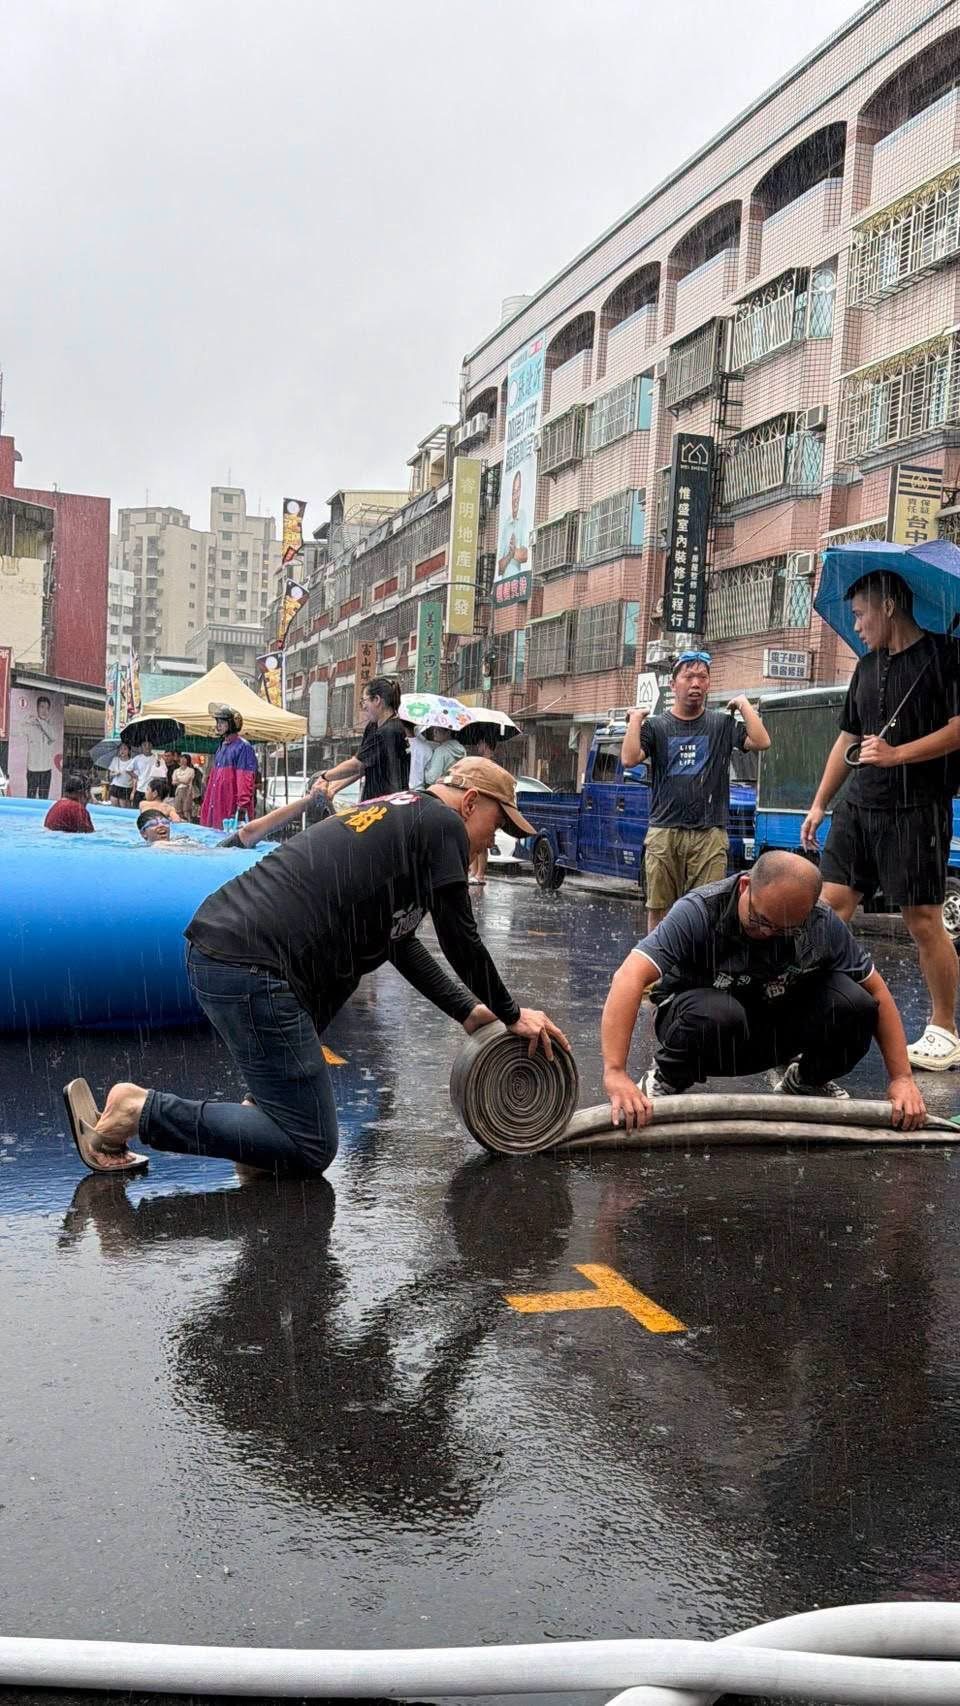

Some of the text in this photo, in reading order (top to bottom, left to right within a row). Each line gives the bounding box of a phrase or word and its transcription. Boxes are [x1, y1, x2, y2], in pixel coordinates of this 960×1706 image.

[671, 485, 691, 627] 惟盛室內裝修工程行
[904, 515, 929, 546] 台中
